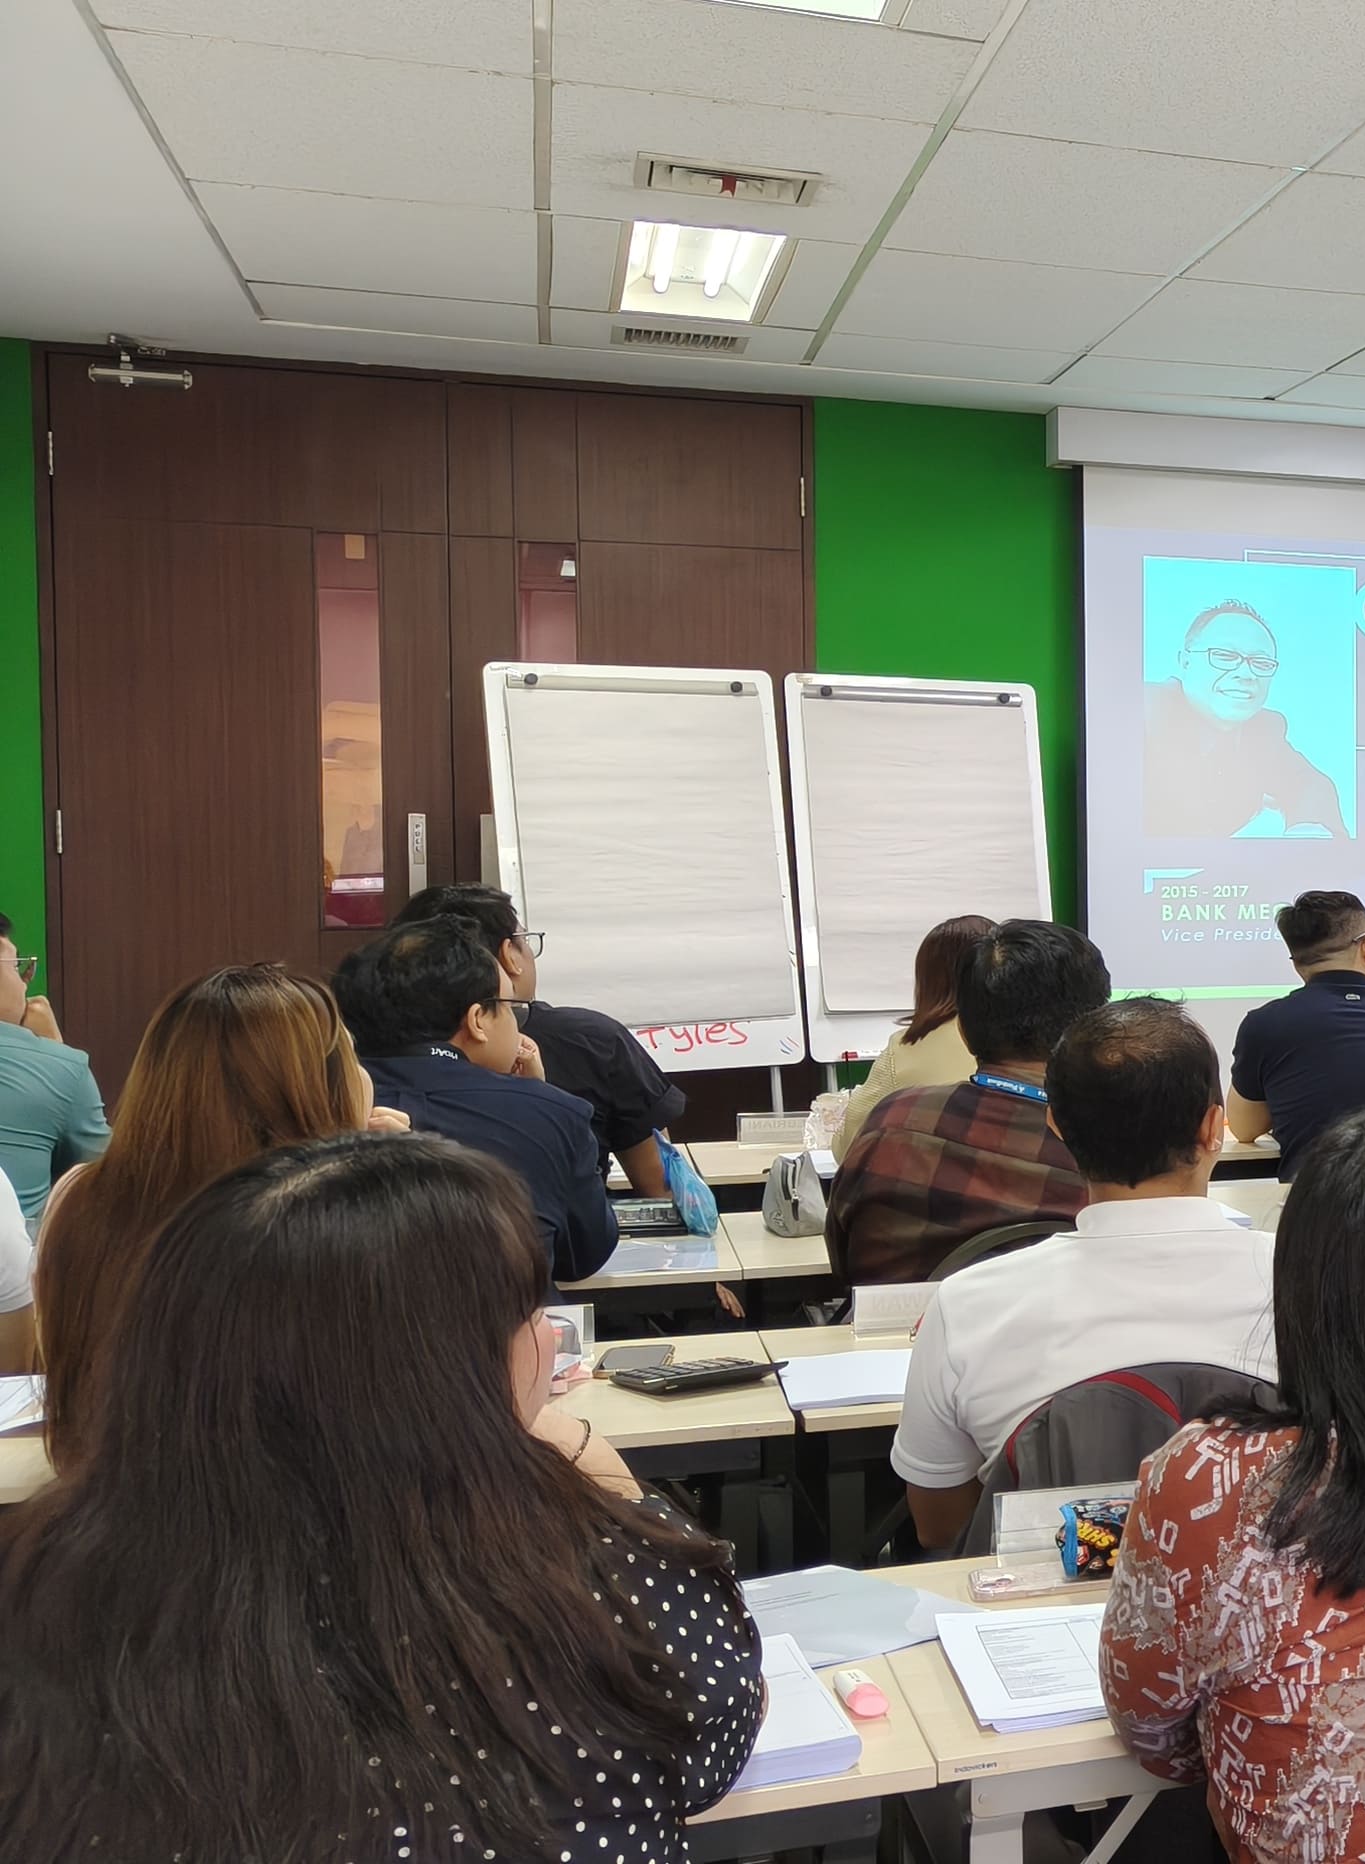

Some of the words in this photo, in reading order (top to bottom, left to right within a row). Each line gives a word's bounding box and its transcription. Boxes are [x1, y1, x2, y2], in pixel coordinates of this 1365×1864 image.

[1161, 885, 1198, 899] 2015
[1214, 885, 1249, 898] 2017
[1162, 904, 1226, 921] BANK
[1161, 928, 1205, 942] Vice
[1214, 927, 1283, 942] Preside
